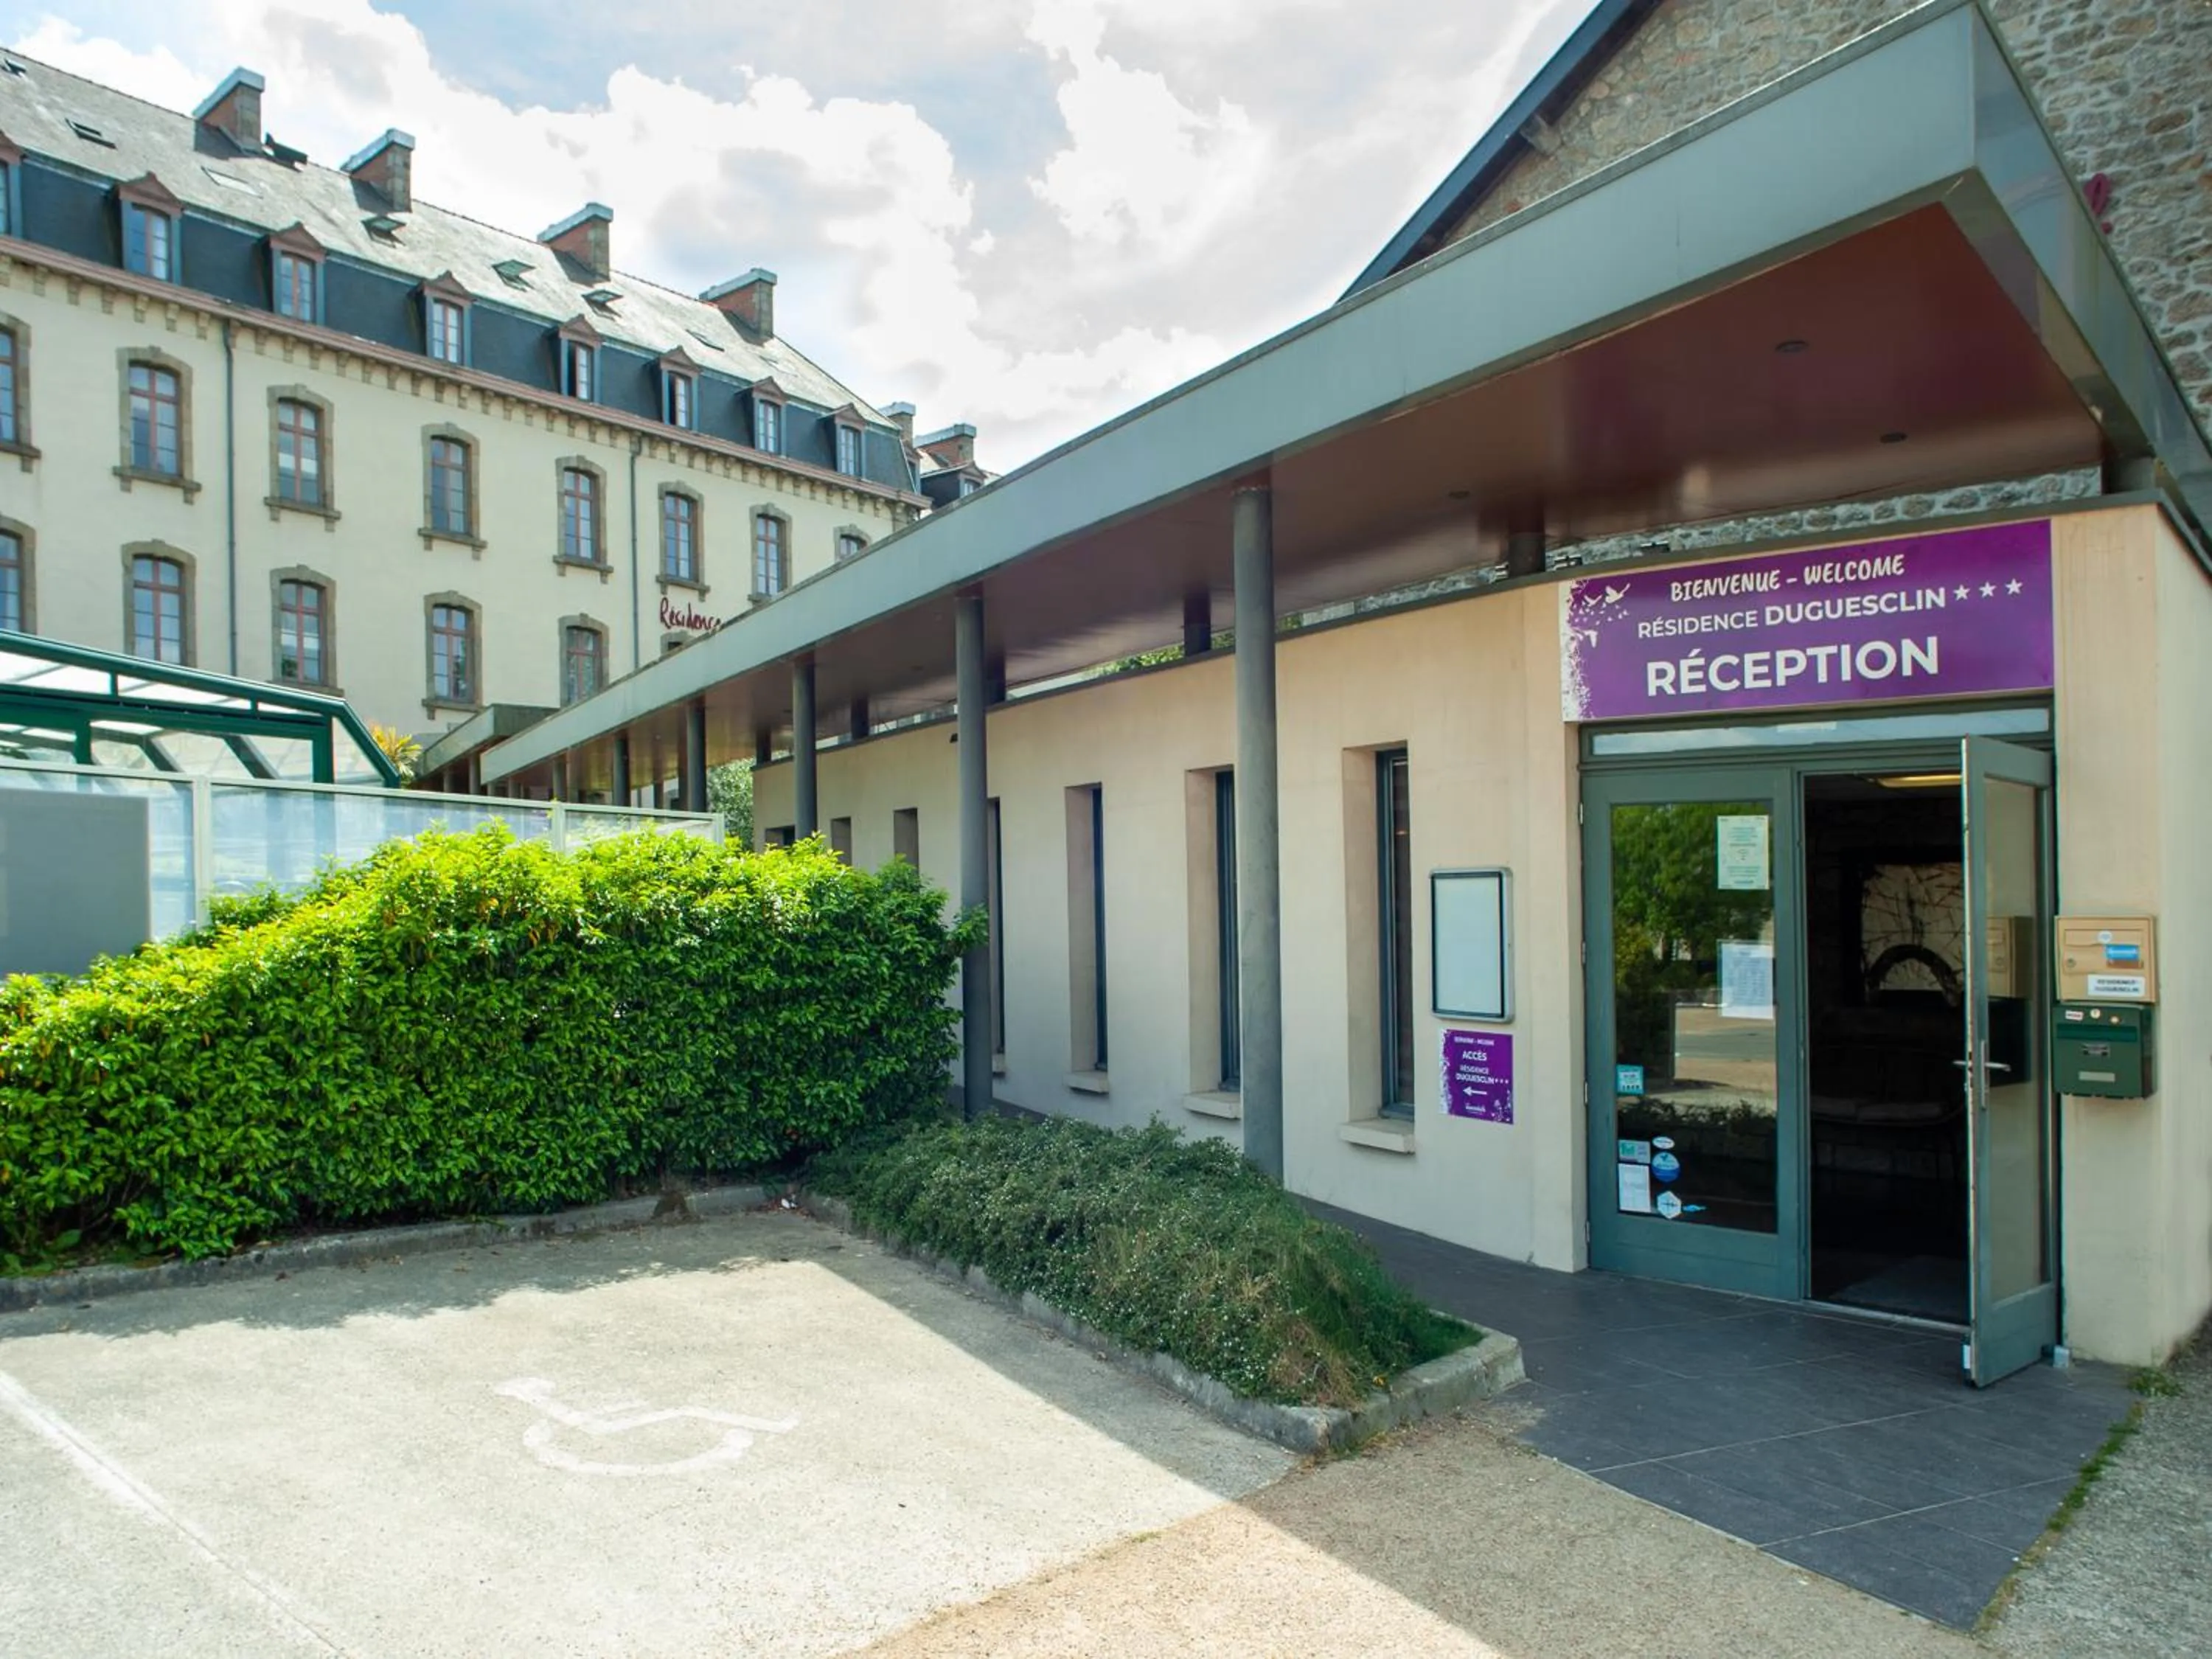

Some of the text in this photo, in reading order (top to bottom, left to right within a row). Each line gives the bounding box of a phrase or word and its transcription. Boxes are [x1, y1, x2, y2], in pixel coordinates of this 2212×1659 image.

[1671, 570, 1781, 602] BIENVENUE
[1804, 554, 1905, 585] WELCOME
[1638, 587, 1946, 639] RÉSIDENCE DUGUESCLIN
[1646, 636, 1938, 697] RÉCEPTION
